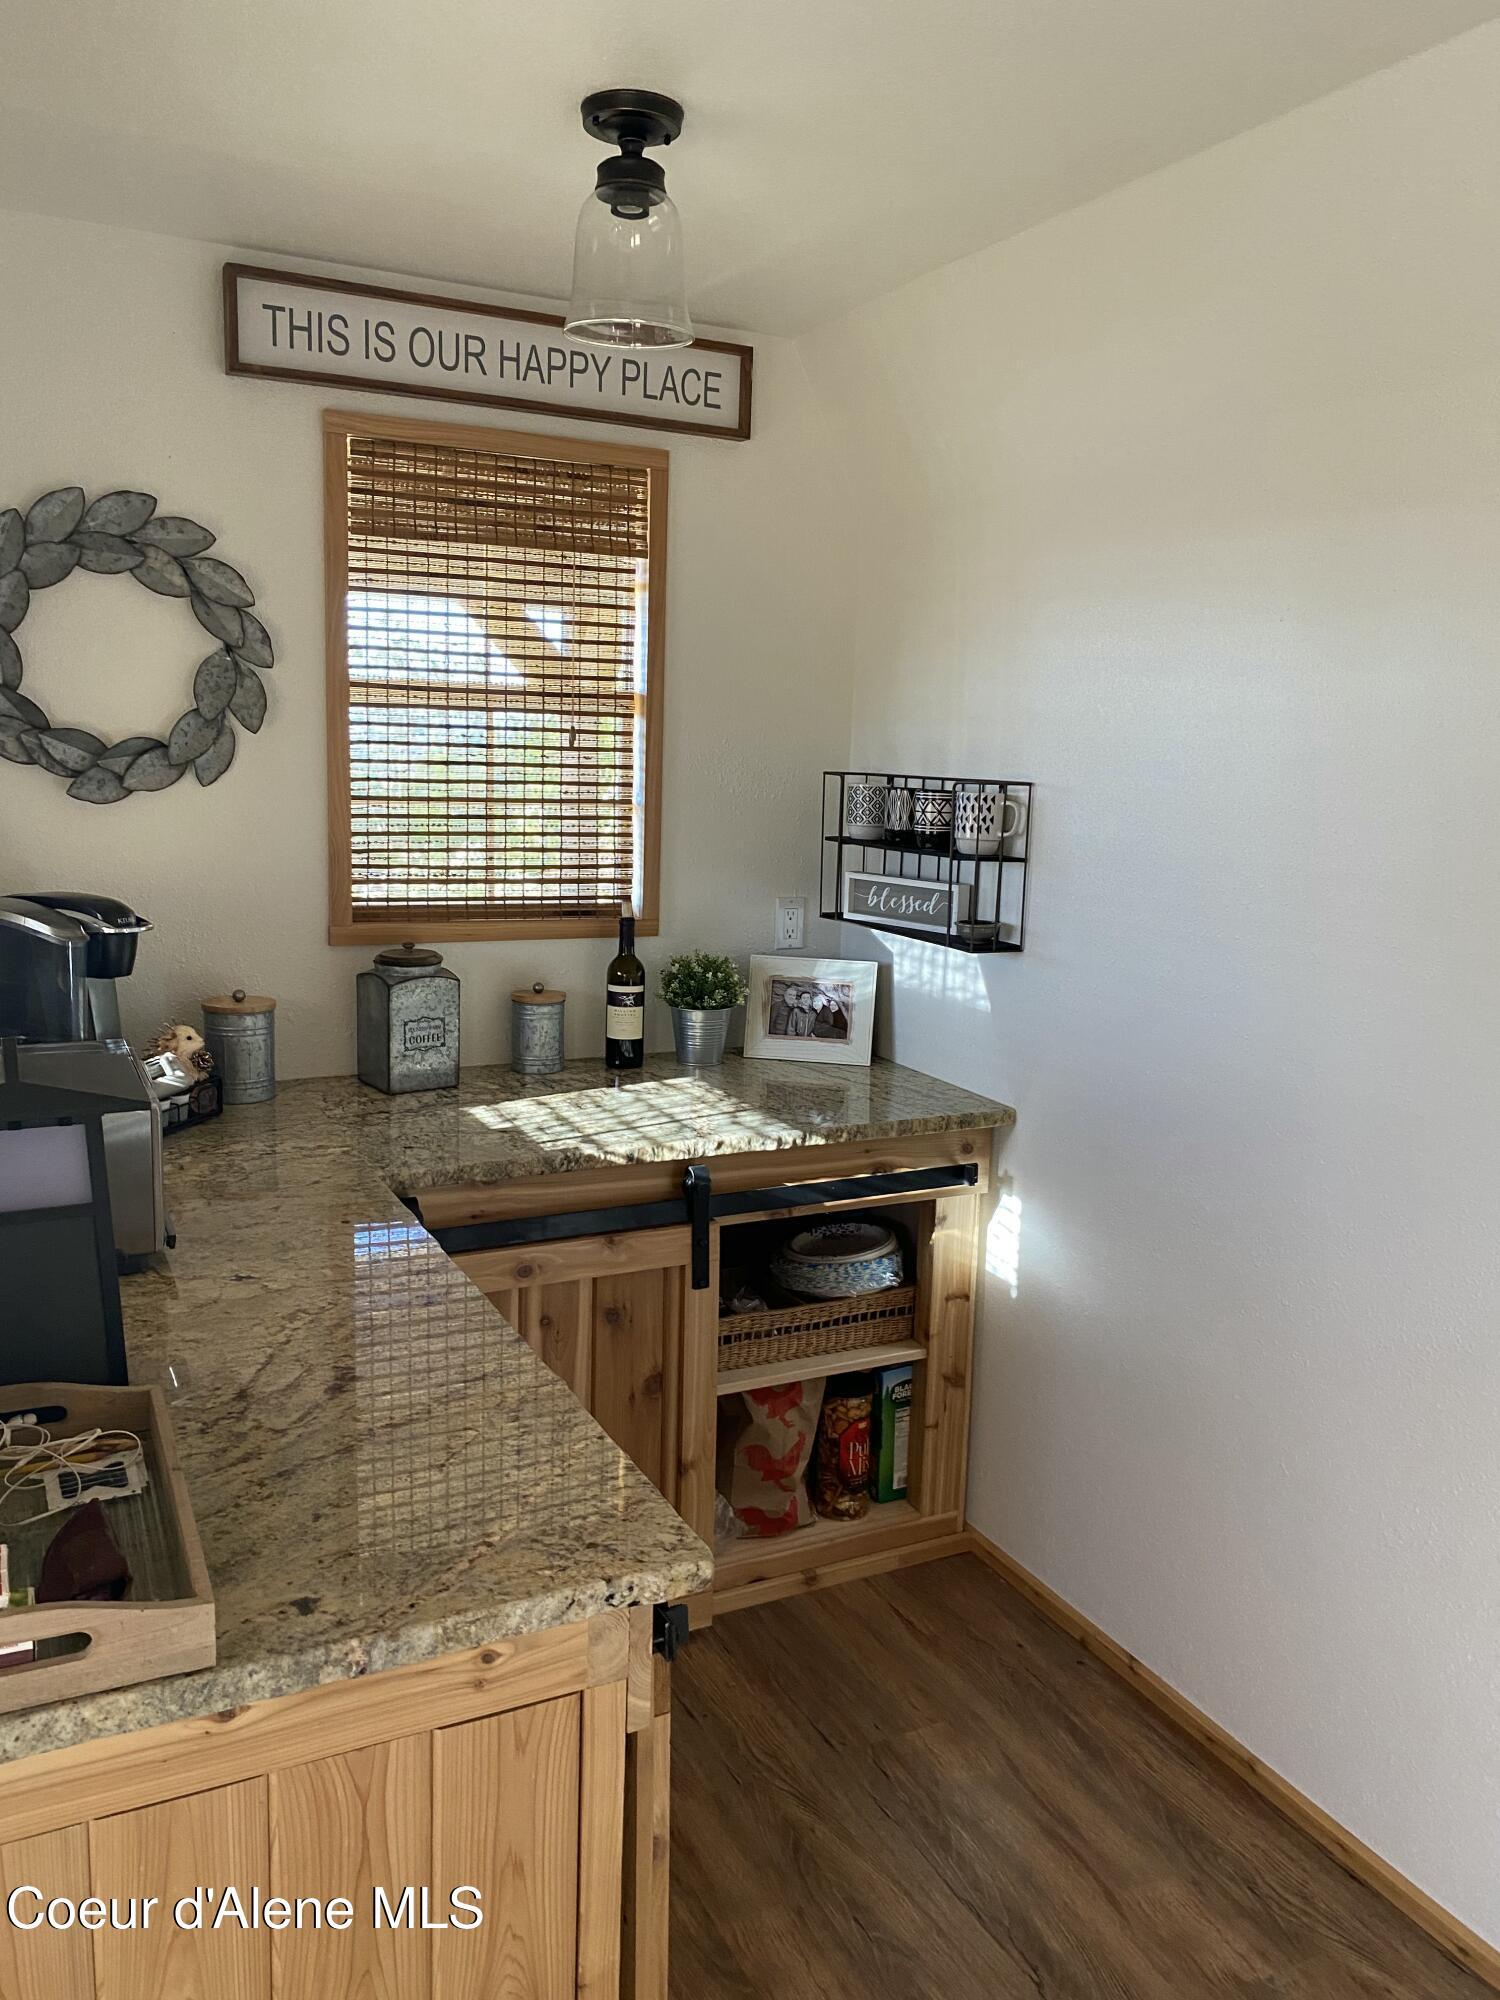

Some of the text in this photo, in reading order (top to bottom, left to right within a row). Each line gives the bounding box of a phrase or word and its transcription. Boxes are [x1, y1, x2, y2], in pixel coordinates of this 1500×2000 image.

[262, 303, 723, 410] THIS IS OUR HAPPY PLACE
[855, 885, 948, 914] blessed
[409, 1032, 442, 1045] COFFEE
